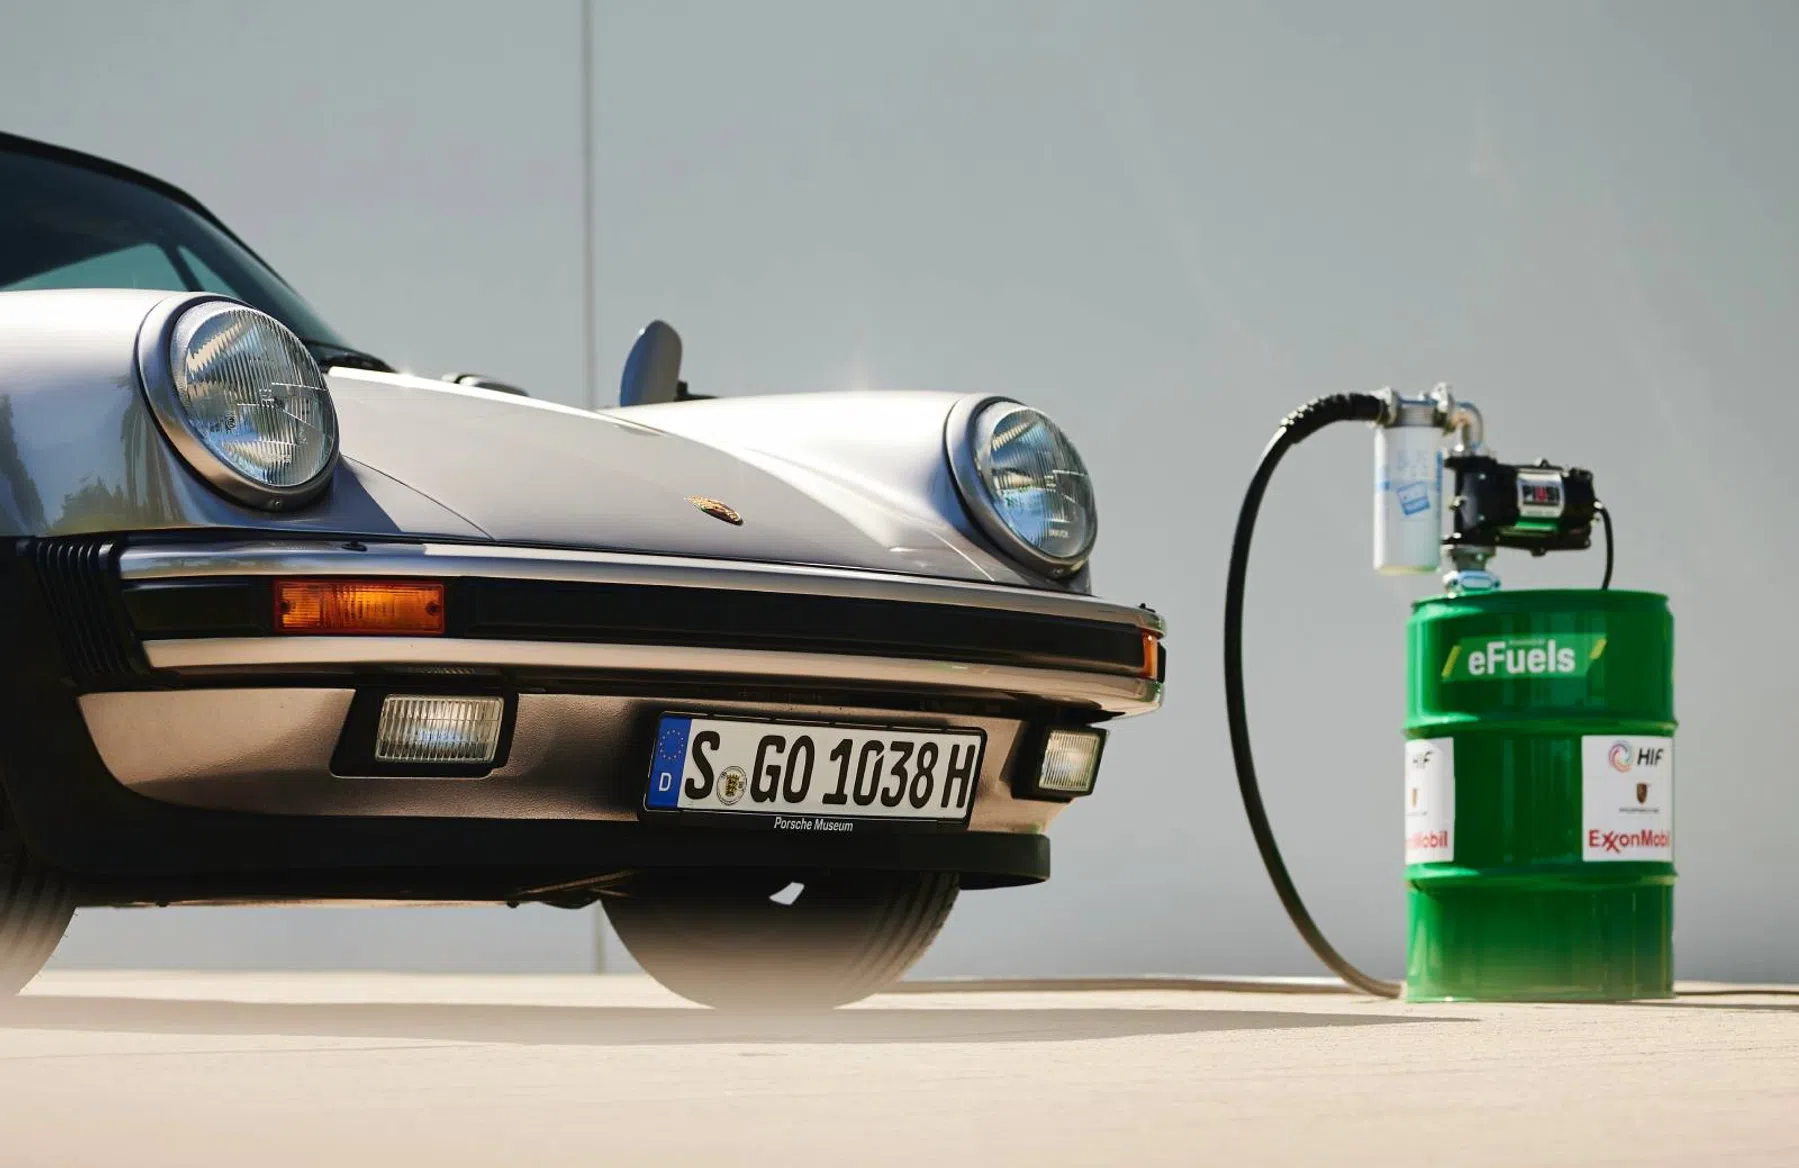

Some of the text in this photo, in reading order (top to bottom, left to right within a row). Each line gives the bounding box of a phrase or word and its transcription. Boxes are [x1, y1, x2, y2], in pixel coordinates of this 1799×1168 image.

[1468, 639, 1576, 675] eFuels
[684, 730, 721, 800] S
[1637, 747, 1664, 765] HIF
[658, 772, 672, 792] D
[773, 816, 854, 831] Porsche Museum
[1588, 829, 1669, 853] ExxonMobi
